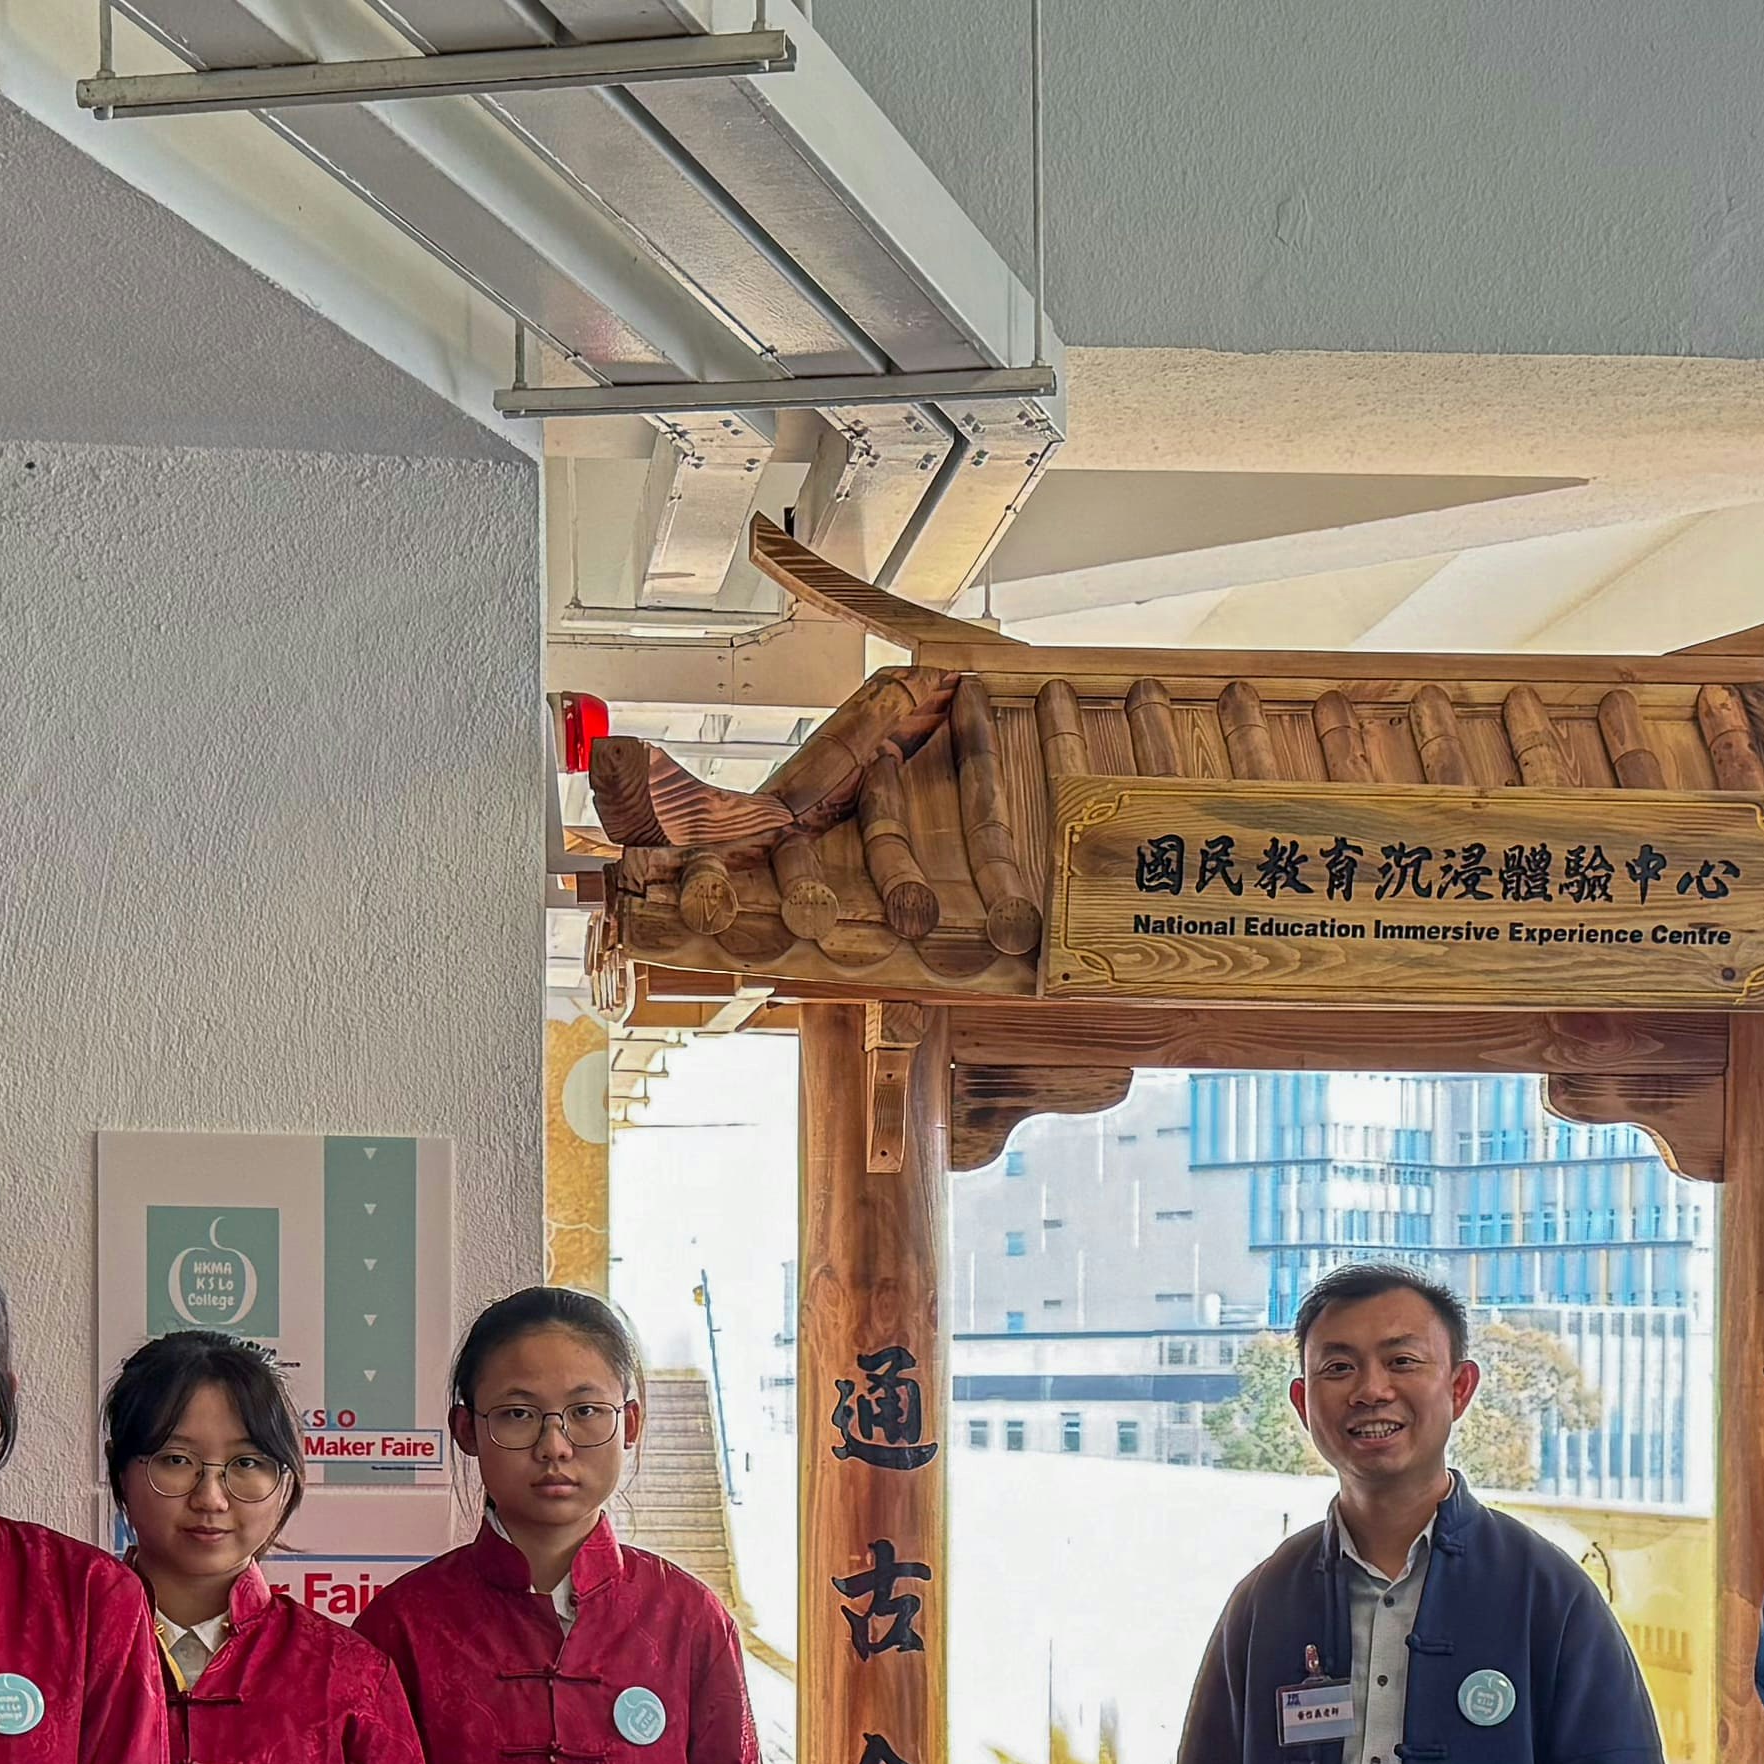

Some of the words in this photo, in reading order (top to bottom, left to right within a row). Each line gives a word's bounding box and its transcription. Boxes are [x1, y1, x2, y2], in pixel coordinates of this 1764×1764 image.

[1135, 834, 1741, 905] 國民教育沉浸體驗中心
[1133, 914, 1235, 936] National
[1244, 917, 1365, 939] Education
[1373, 919, 1500, 942] Immersive
[1508, 922, 1643, 945] Experience
[1651, 925, 1732, 945] Centre
[193, 1261, 233, 1275] HKMA
[218, 1277, 234, 1290] Lo
[188, 1293, 234, 1311] College
[304, 1436, 376, 1457] Maker
[381, 1437, 435, 1457] Faire
[304, 1572, 384, 1615] Fai
